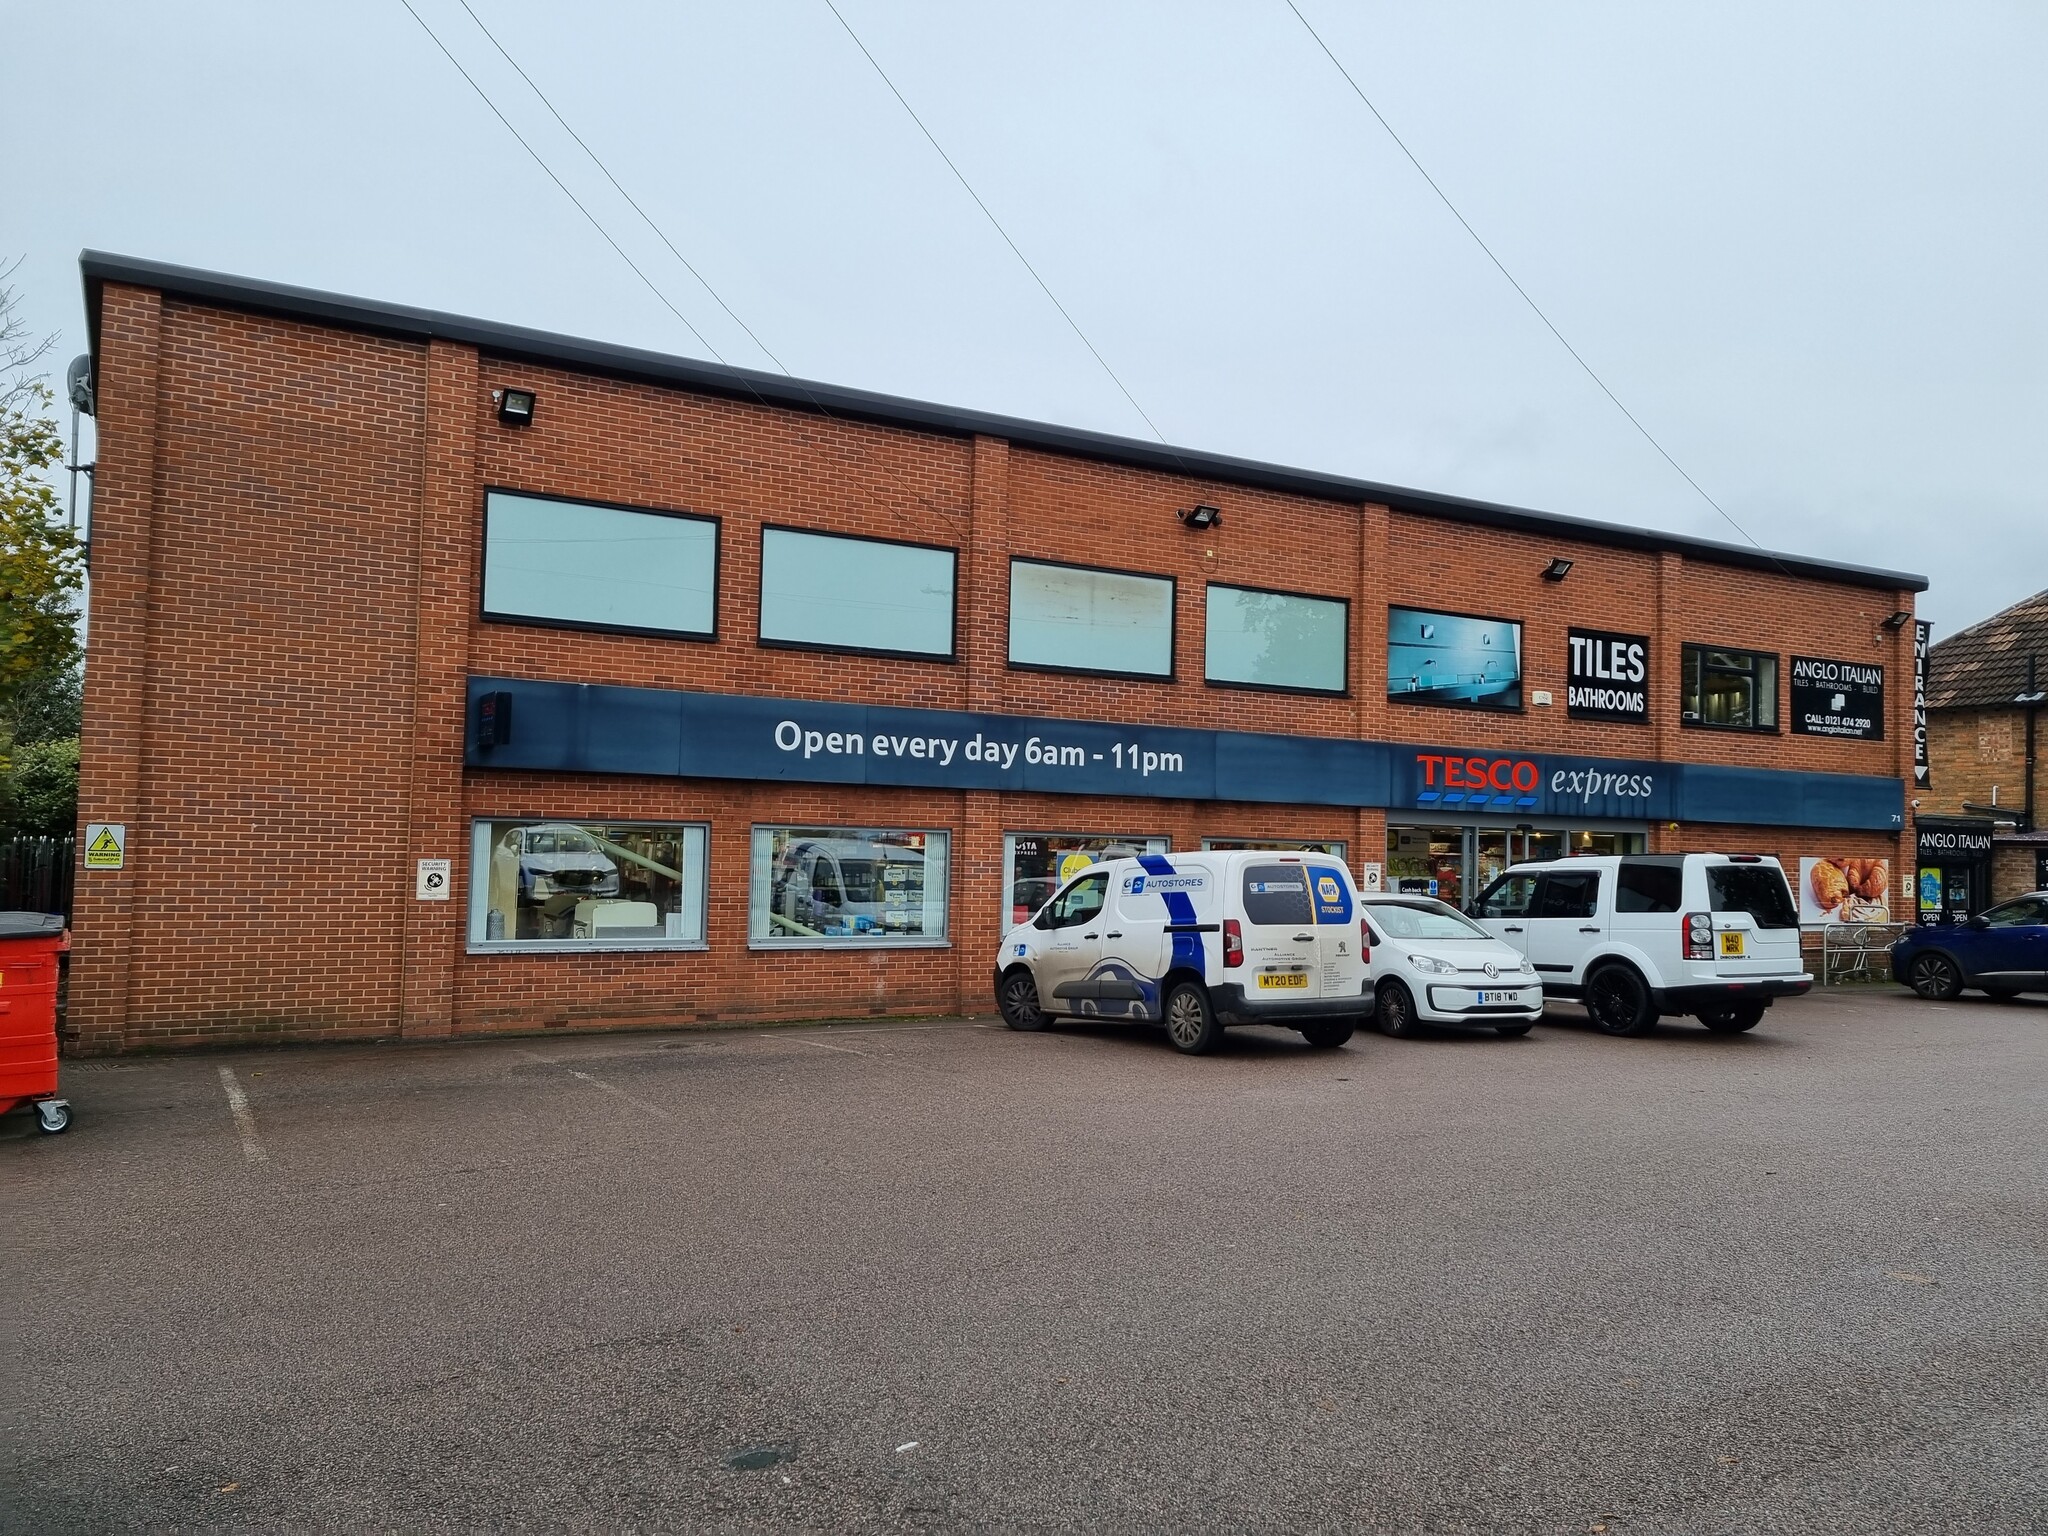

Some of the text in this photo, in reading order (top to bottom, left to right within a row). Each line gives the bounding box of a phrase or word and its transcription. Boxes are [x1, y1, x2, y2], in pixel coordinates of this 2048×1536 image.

[1569, 636, 1645, 683] TILES
[1793, 660, 1881, 685] ANGLO ITALIAN
[1793, 678, 1809, 687] TILES
[1815, 680, 1852, 692] BATHROOMS
[1862, 685, 1878, 694] BUILD
[1914, 624, 1926, 760] ENTRANCE
[1568, 685, 1644, 712] BATHROOMS
[1804, 713, 1871, 728] CALL: 0121 474 2920
[774, 720, 864, 758] Open
[871, 733, 958, 766] every
[964, 733, 1019, 769] day
[1024, 736, 1085, 766] 6am
[1111, 742, 1183, 776] 11pm
[1416, 755, 1653, 804] TESCO express
[1890, 814, 1901, 823] 71
[1920, 832, 1991, 849] ANGLO ITALIAN
[1920, 848, 1932, 856] TILES
[1145, 878, 1203, 888] AUTOSTORES
[1320, 883, 1338, 896] NAPA
[1320, 905, 1344, 914] STOCKIST
[1922, 913, 1940, 922] OPEN
[1263, 975, 1304, 986] MT20 EDF
[1484, 992, 1518, 1002] BT18 TWD
